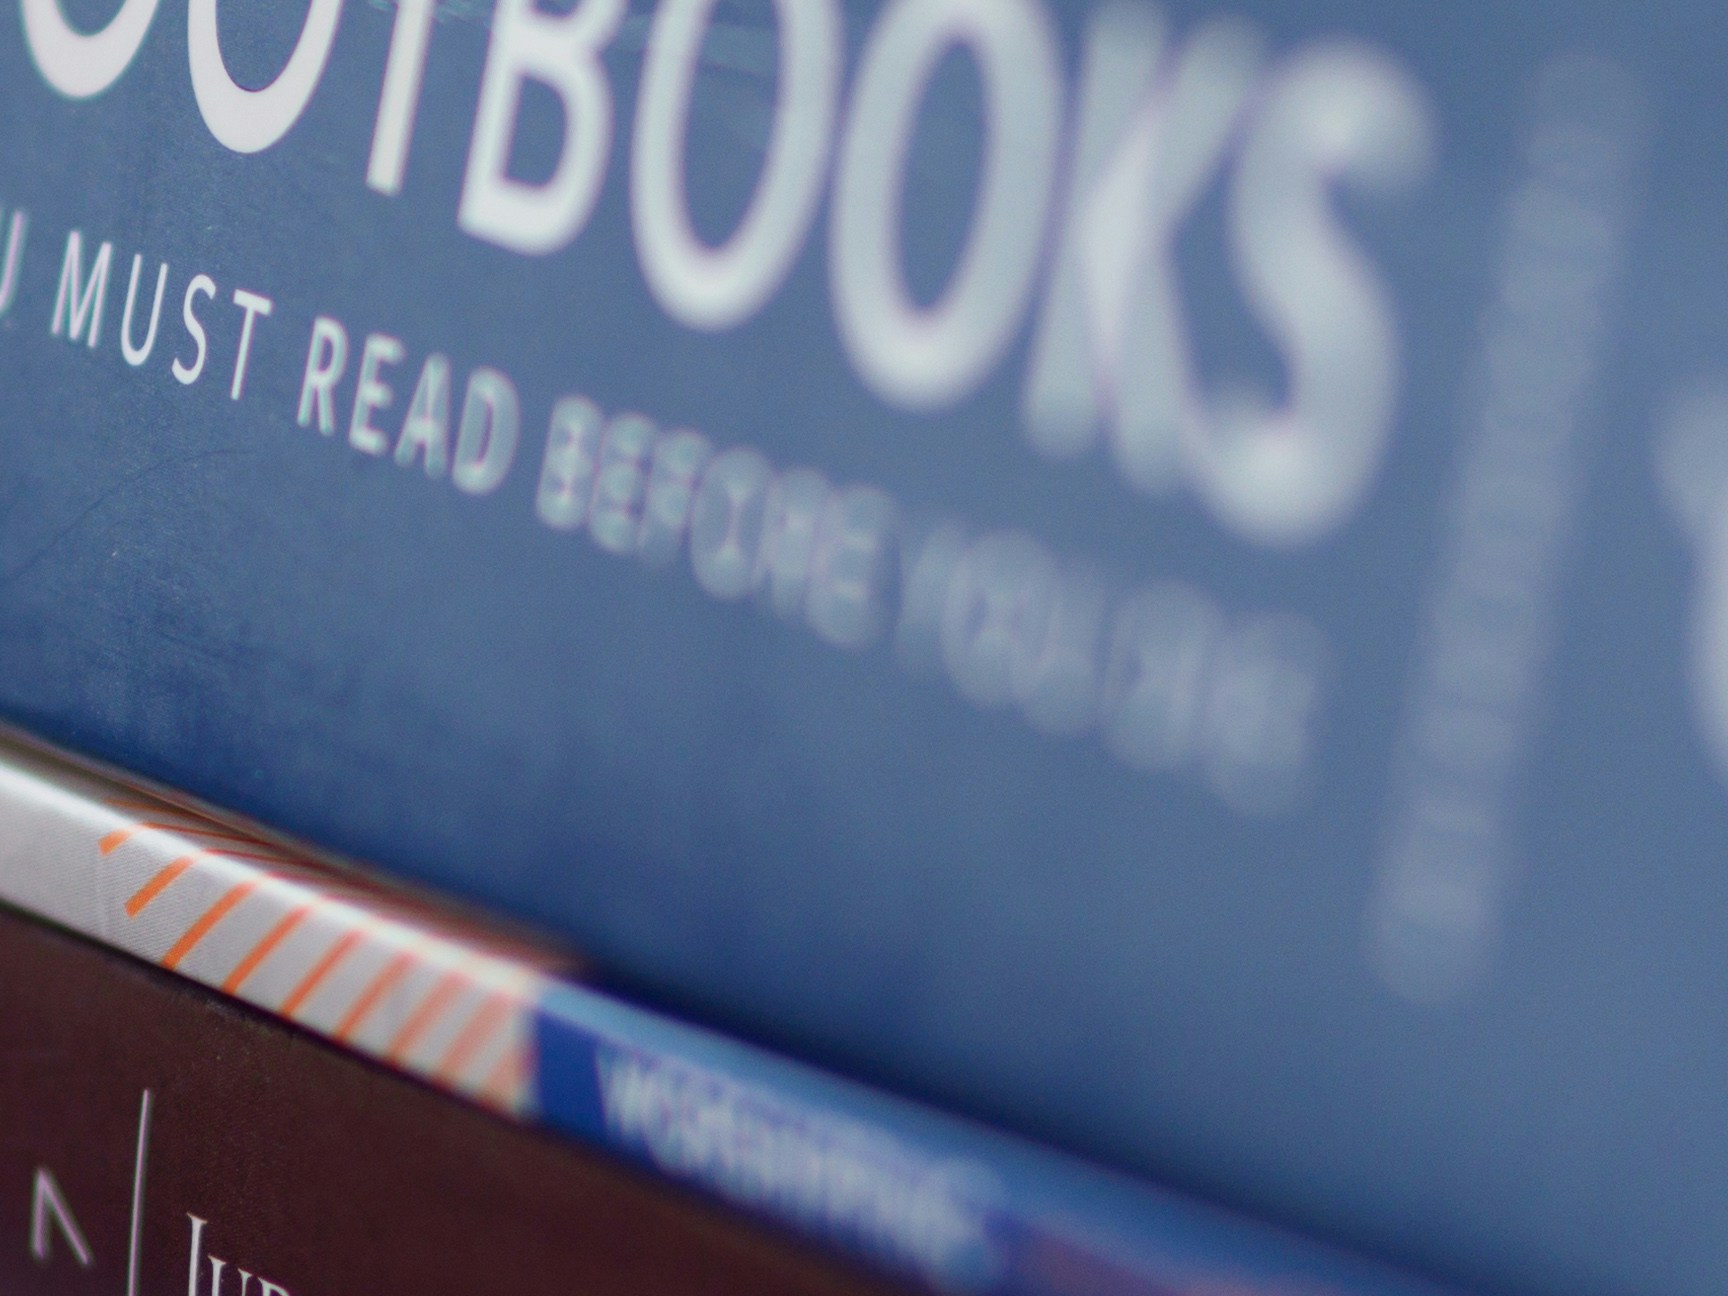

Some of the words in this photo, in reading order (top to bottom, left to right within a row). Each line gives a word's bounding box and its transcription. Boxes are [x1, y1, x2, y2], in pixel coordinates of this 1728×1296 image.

[51, 229, 272, 403] MUST
[294, 316, 522, 496] READ
[535, 394, 902, 649] BEFORE
